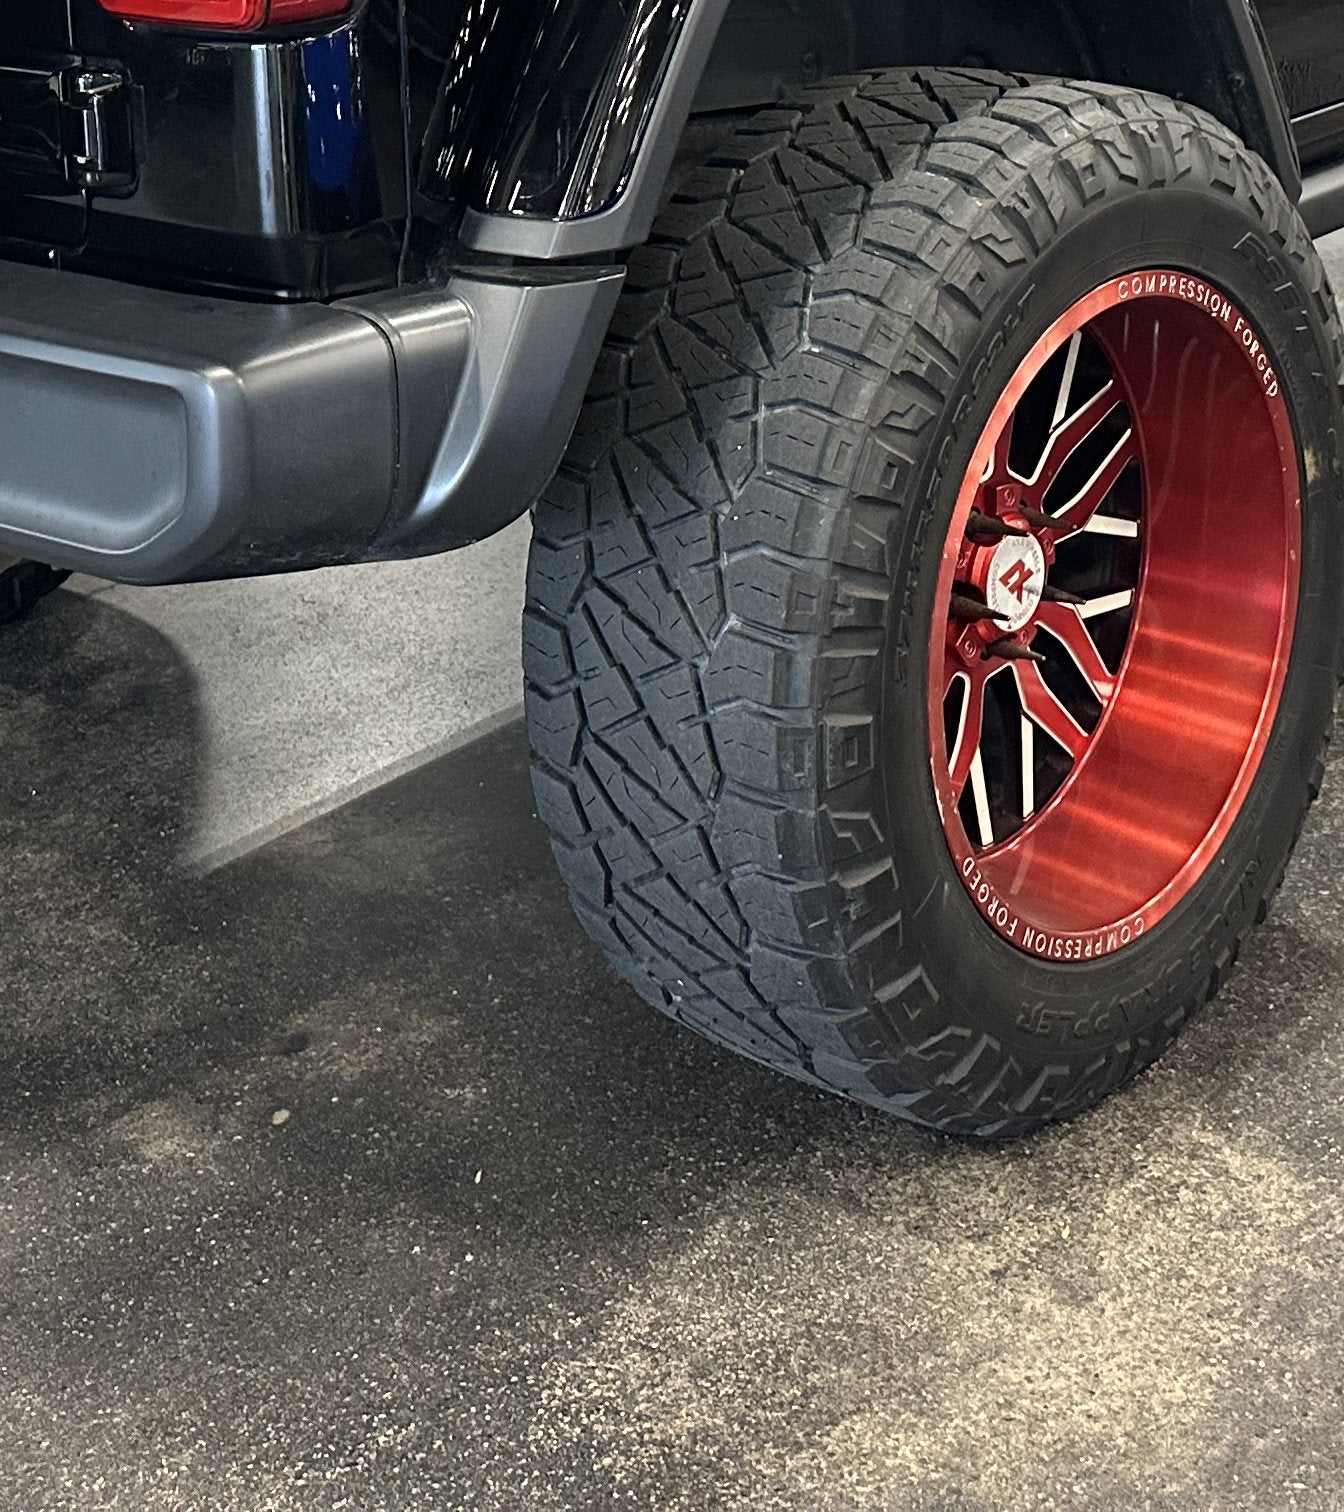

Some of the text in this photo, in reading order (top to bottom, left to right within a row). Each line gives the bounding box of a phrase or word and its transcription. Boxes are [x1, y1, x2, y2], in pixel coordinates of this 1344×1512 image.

[1117, 274, 1233, 323] COMPRESSION
[1234, 317, 1279, 398] FORGED
[962, 856, 1146, 959] COMPRESSION FORGED
